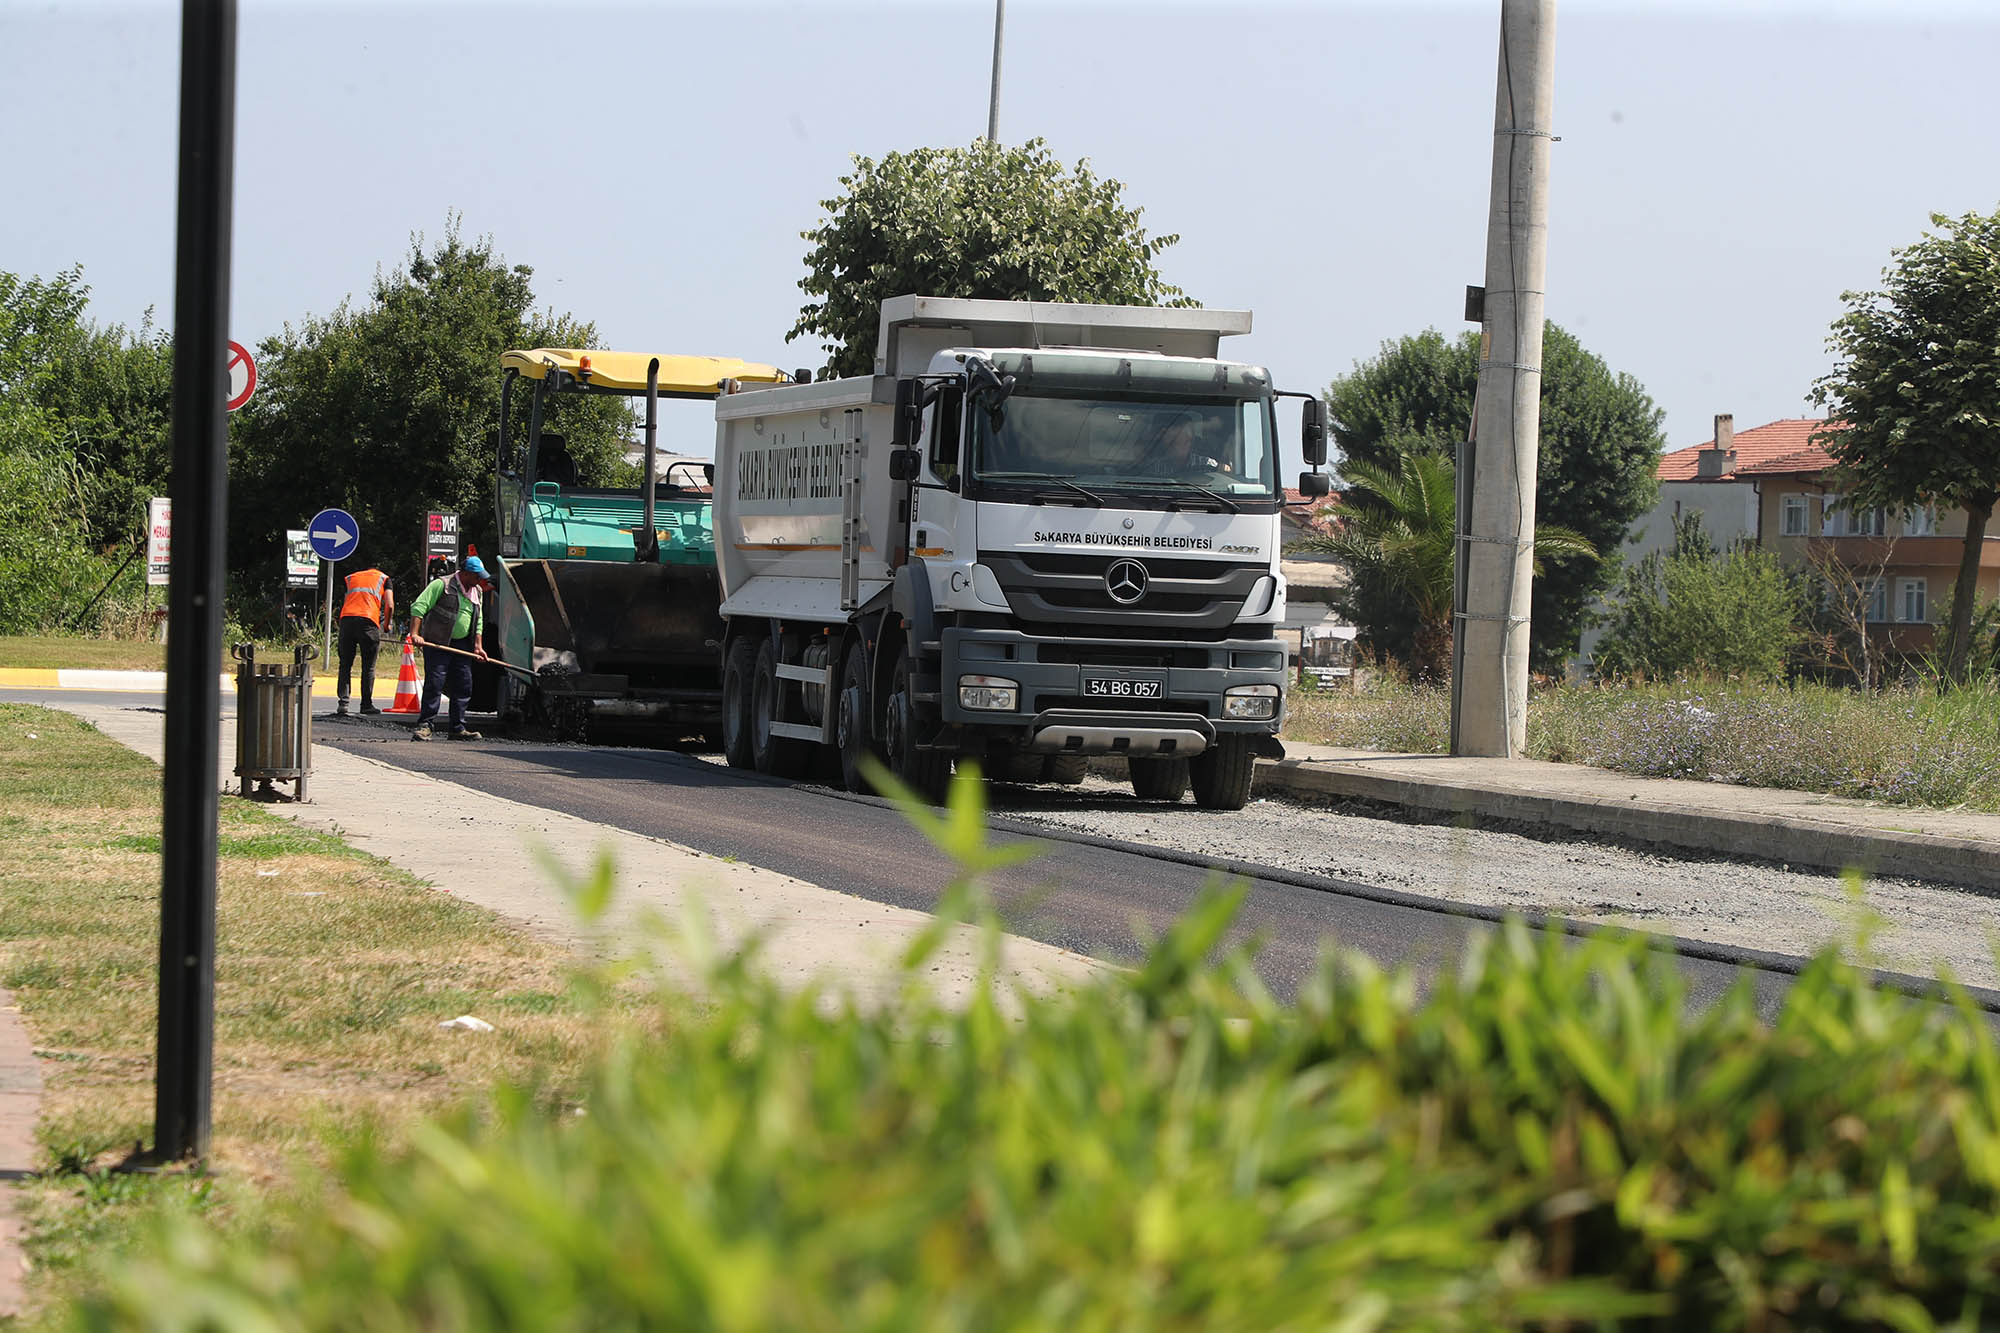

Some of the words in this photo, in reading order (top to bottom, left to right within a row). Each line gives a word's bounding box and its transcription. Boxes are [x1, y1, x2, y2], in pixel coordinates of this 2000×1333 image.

[739, 450, 766, 500] SAKARYA
[767, 432, 808, 507] BÜYÜKŞEHİR
[1034, 531, 1081, 544] SAKARYA
[1084, 531, 1151, 548] BÜYÜKŞEHİR
[1153, 536, 1213, 549] BELEDİYESİ
[1219, 544, 1260, 555] AXOR
[1090, 680, 1108, 695] 54
[1111, 681, 1132, 696] BG
[1134, 682, 1159, 697] 057
